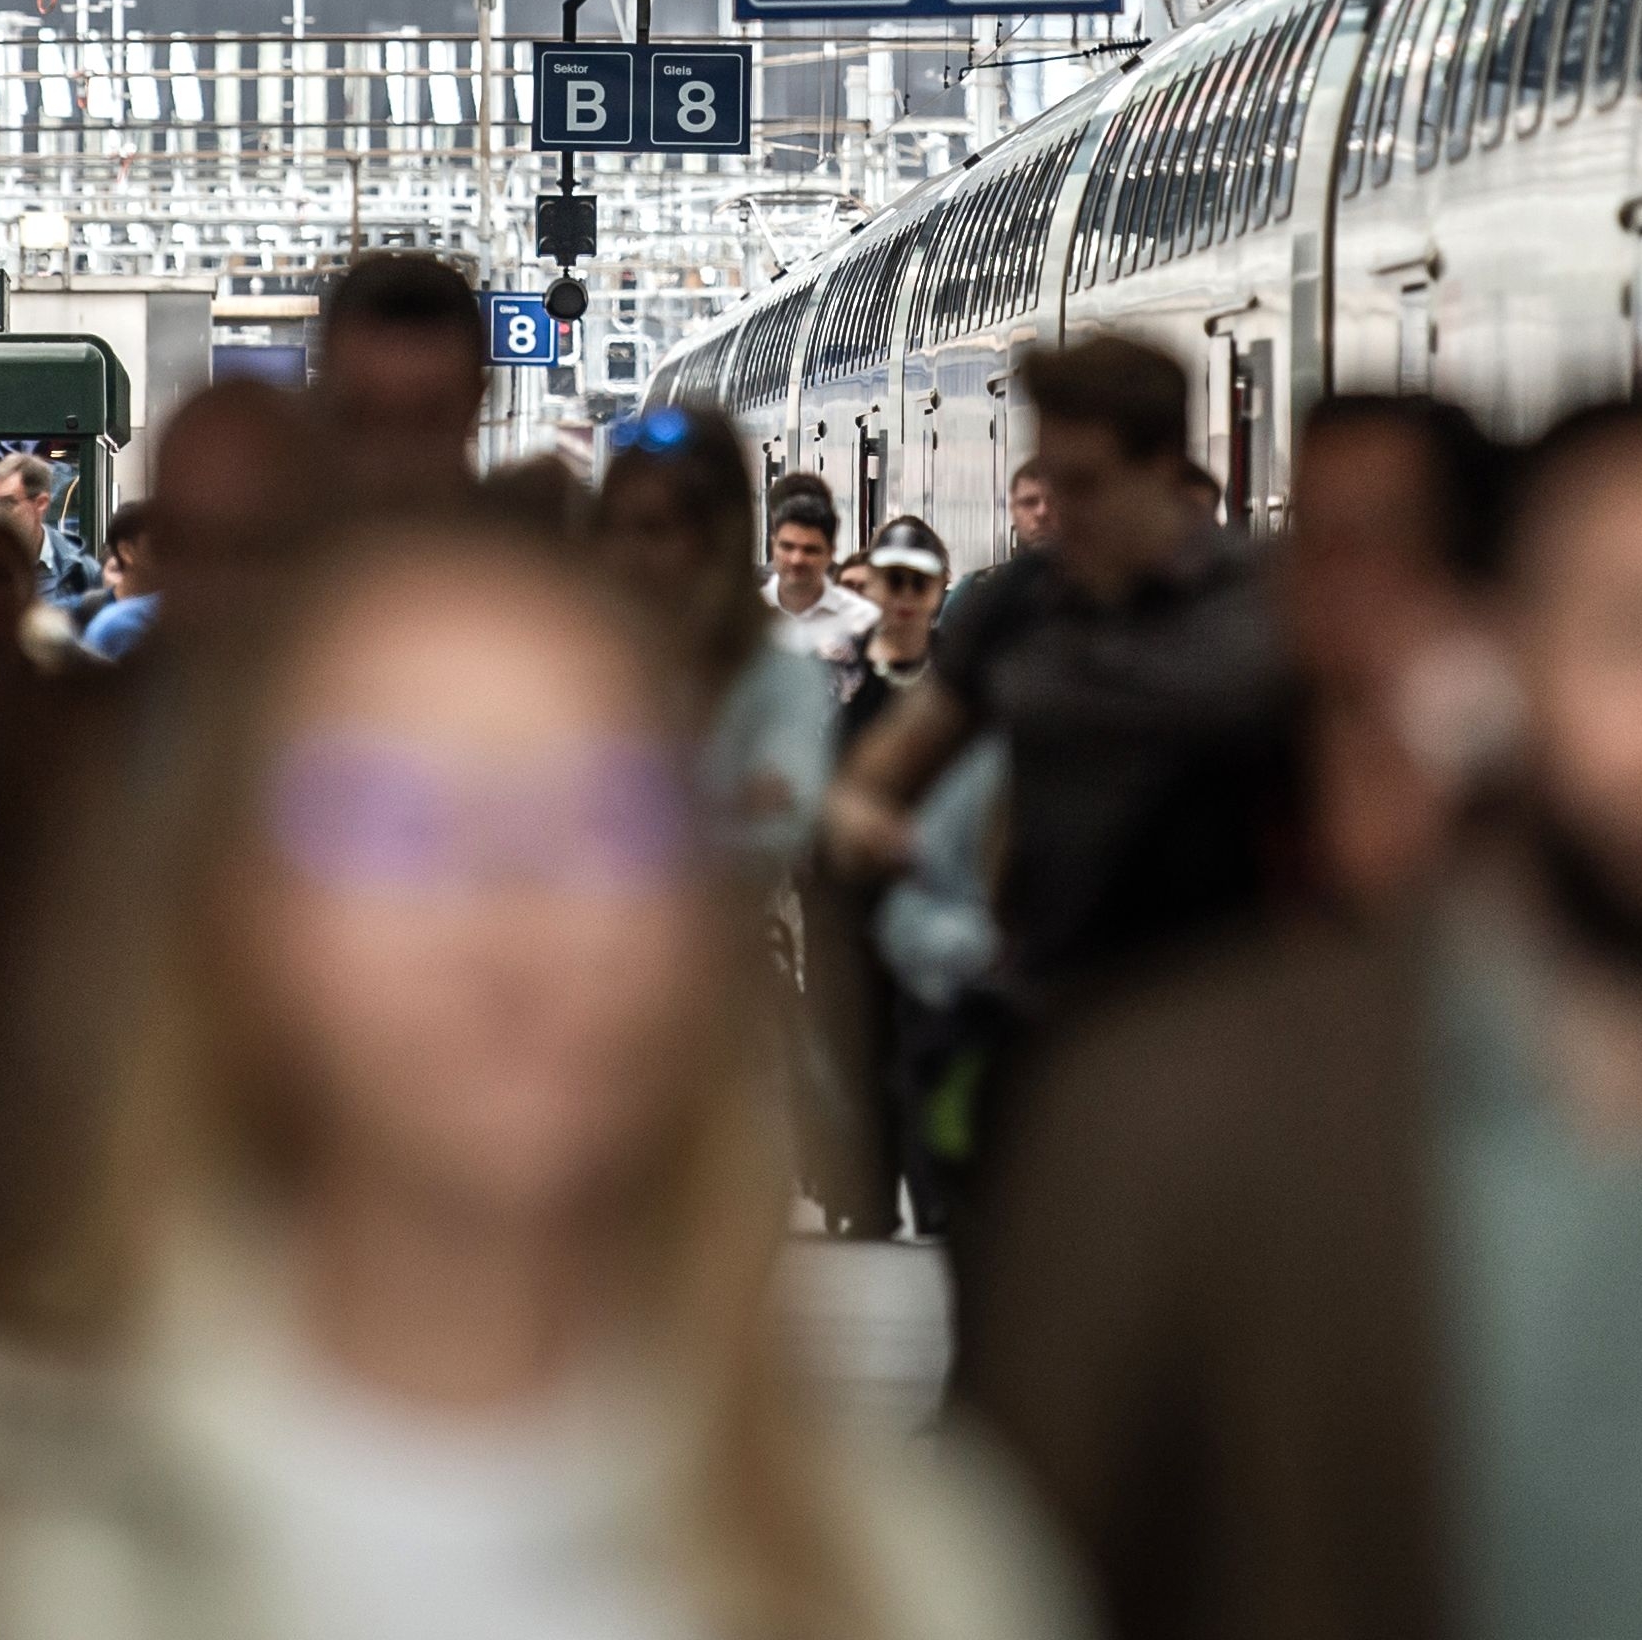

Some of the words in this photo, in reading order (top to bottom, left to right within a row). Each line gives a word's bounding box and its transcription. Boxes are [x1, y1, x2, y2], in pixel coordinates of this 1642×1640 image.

[553, 63, 589, 74] Sektor
[663, 65, 693, 76] Gleis
[566, 80, 607, 132] B
[676, 80, 716, 133] 8
[508, 314, 537, 354] 8
